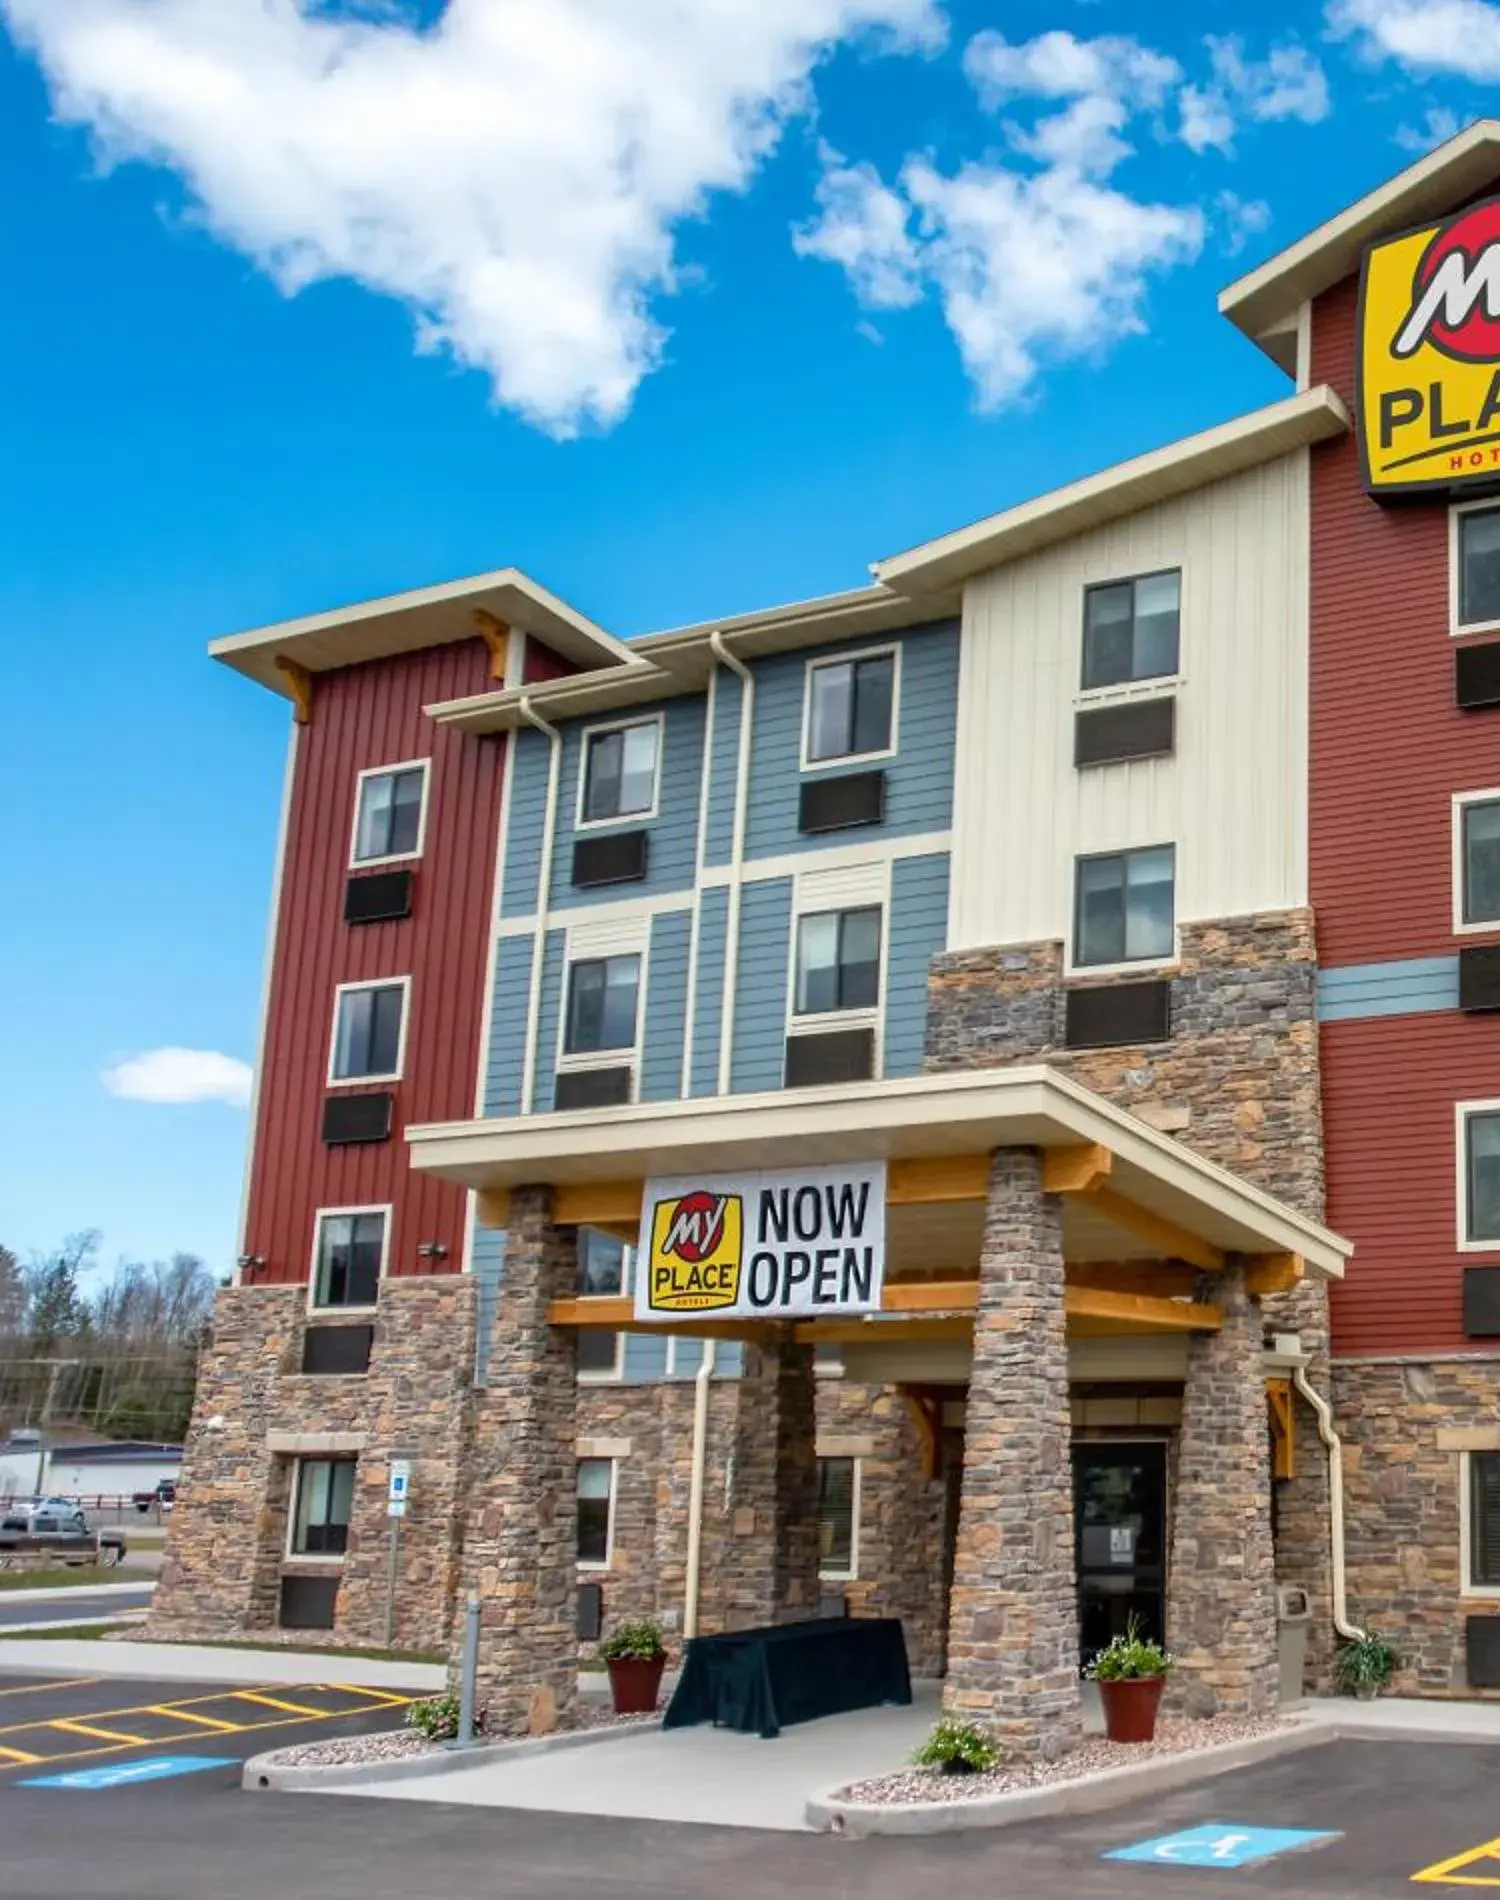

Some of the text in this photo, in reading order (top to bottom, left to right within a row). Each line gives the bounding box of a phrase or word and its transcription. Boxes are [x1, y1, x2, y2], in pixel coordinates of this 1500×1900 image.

[757, 1181, 871, 1244] NOW
[655, 1263, 733, 1293] PLACE
[747, 1246, 874, 1308] OPEN
